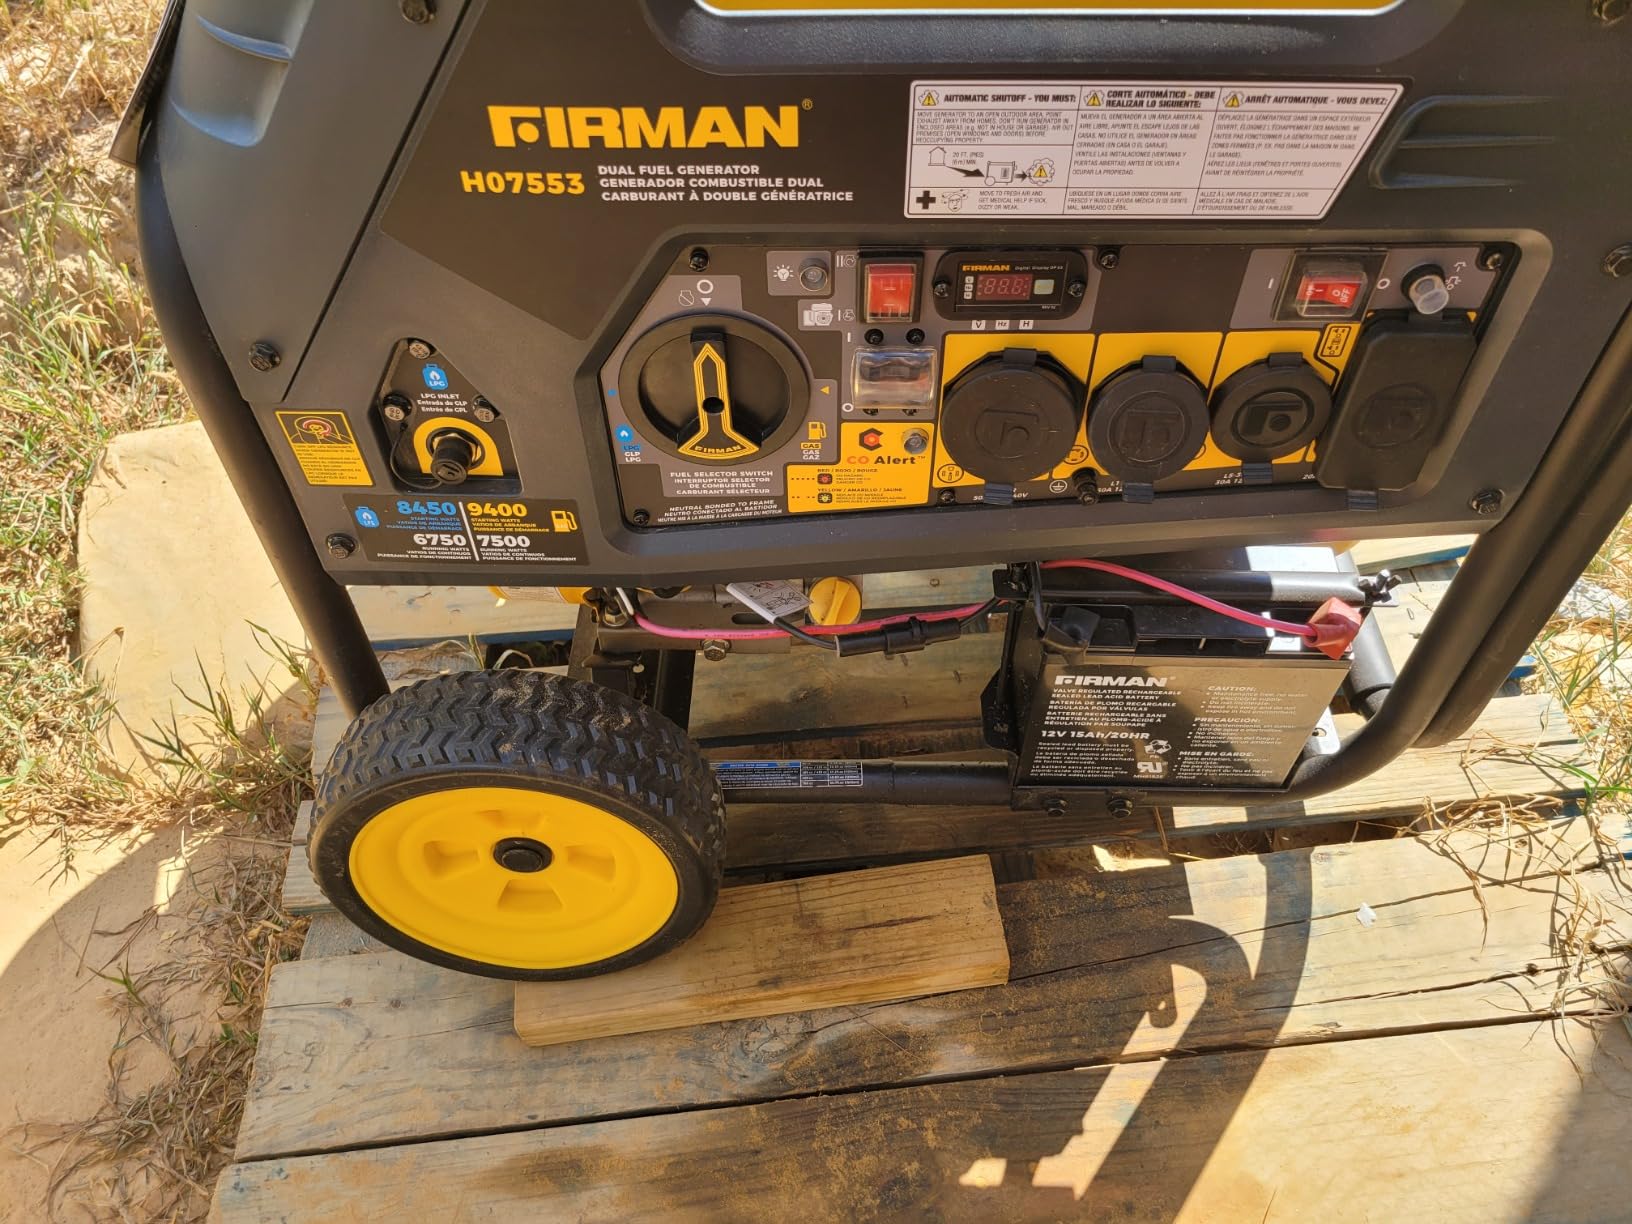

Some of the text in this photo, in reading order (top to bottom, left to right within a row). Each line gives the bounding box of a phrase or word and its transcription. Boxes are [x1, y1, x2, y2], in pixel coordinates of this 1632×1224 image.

[1053, 94, 1076, 102] MUST:
[1135, 90, 1186, 98] AUTOMÁTICO
[1245, 95, 1271, 104] ARRÊT
[1273, 96, 1327, 105] AUTOMATIQUE
[1360, 97, 1388, 105] DEVEZ:
[598, 165, 759, 175] DUAL FUEL GENERATOR
[460, 170, 585, 195] H07553
[600, 178, 823, 188] GENERADOR COMBUSTIBLE DUAL
[602, 188, 853, 202] CARBURANT À DOUBLE GÉNÉRATRICE
[1340, 288, 1350, 303] OFF
[847, 456, 869, 464] CO
[396, 500, 527, 517] 8450 9400
[413, 534, 531, 548] 6750 7500
[1070, 731, 1150, 739] 15Ah/20HR
